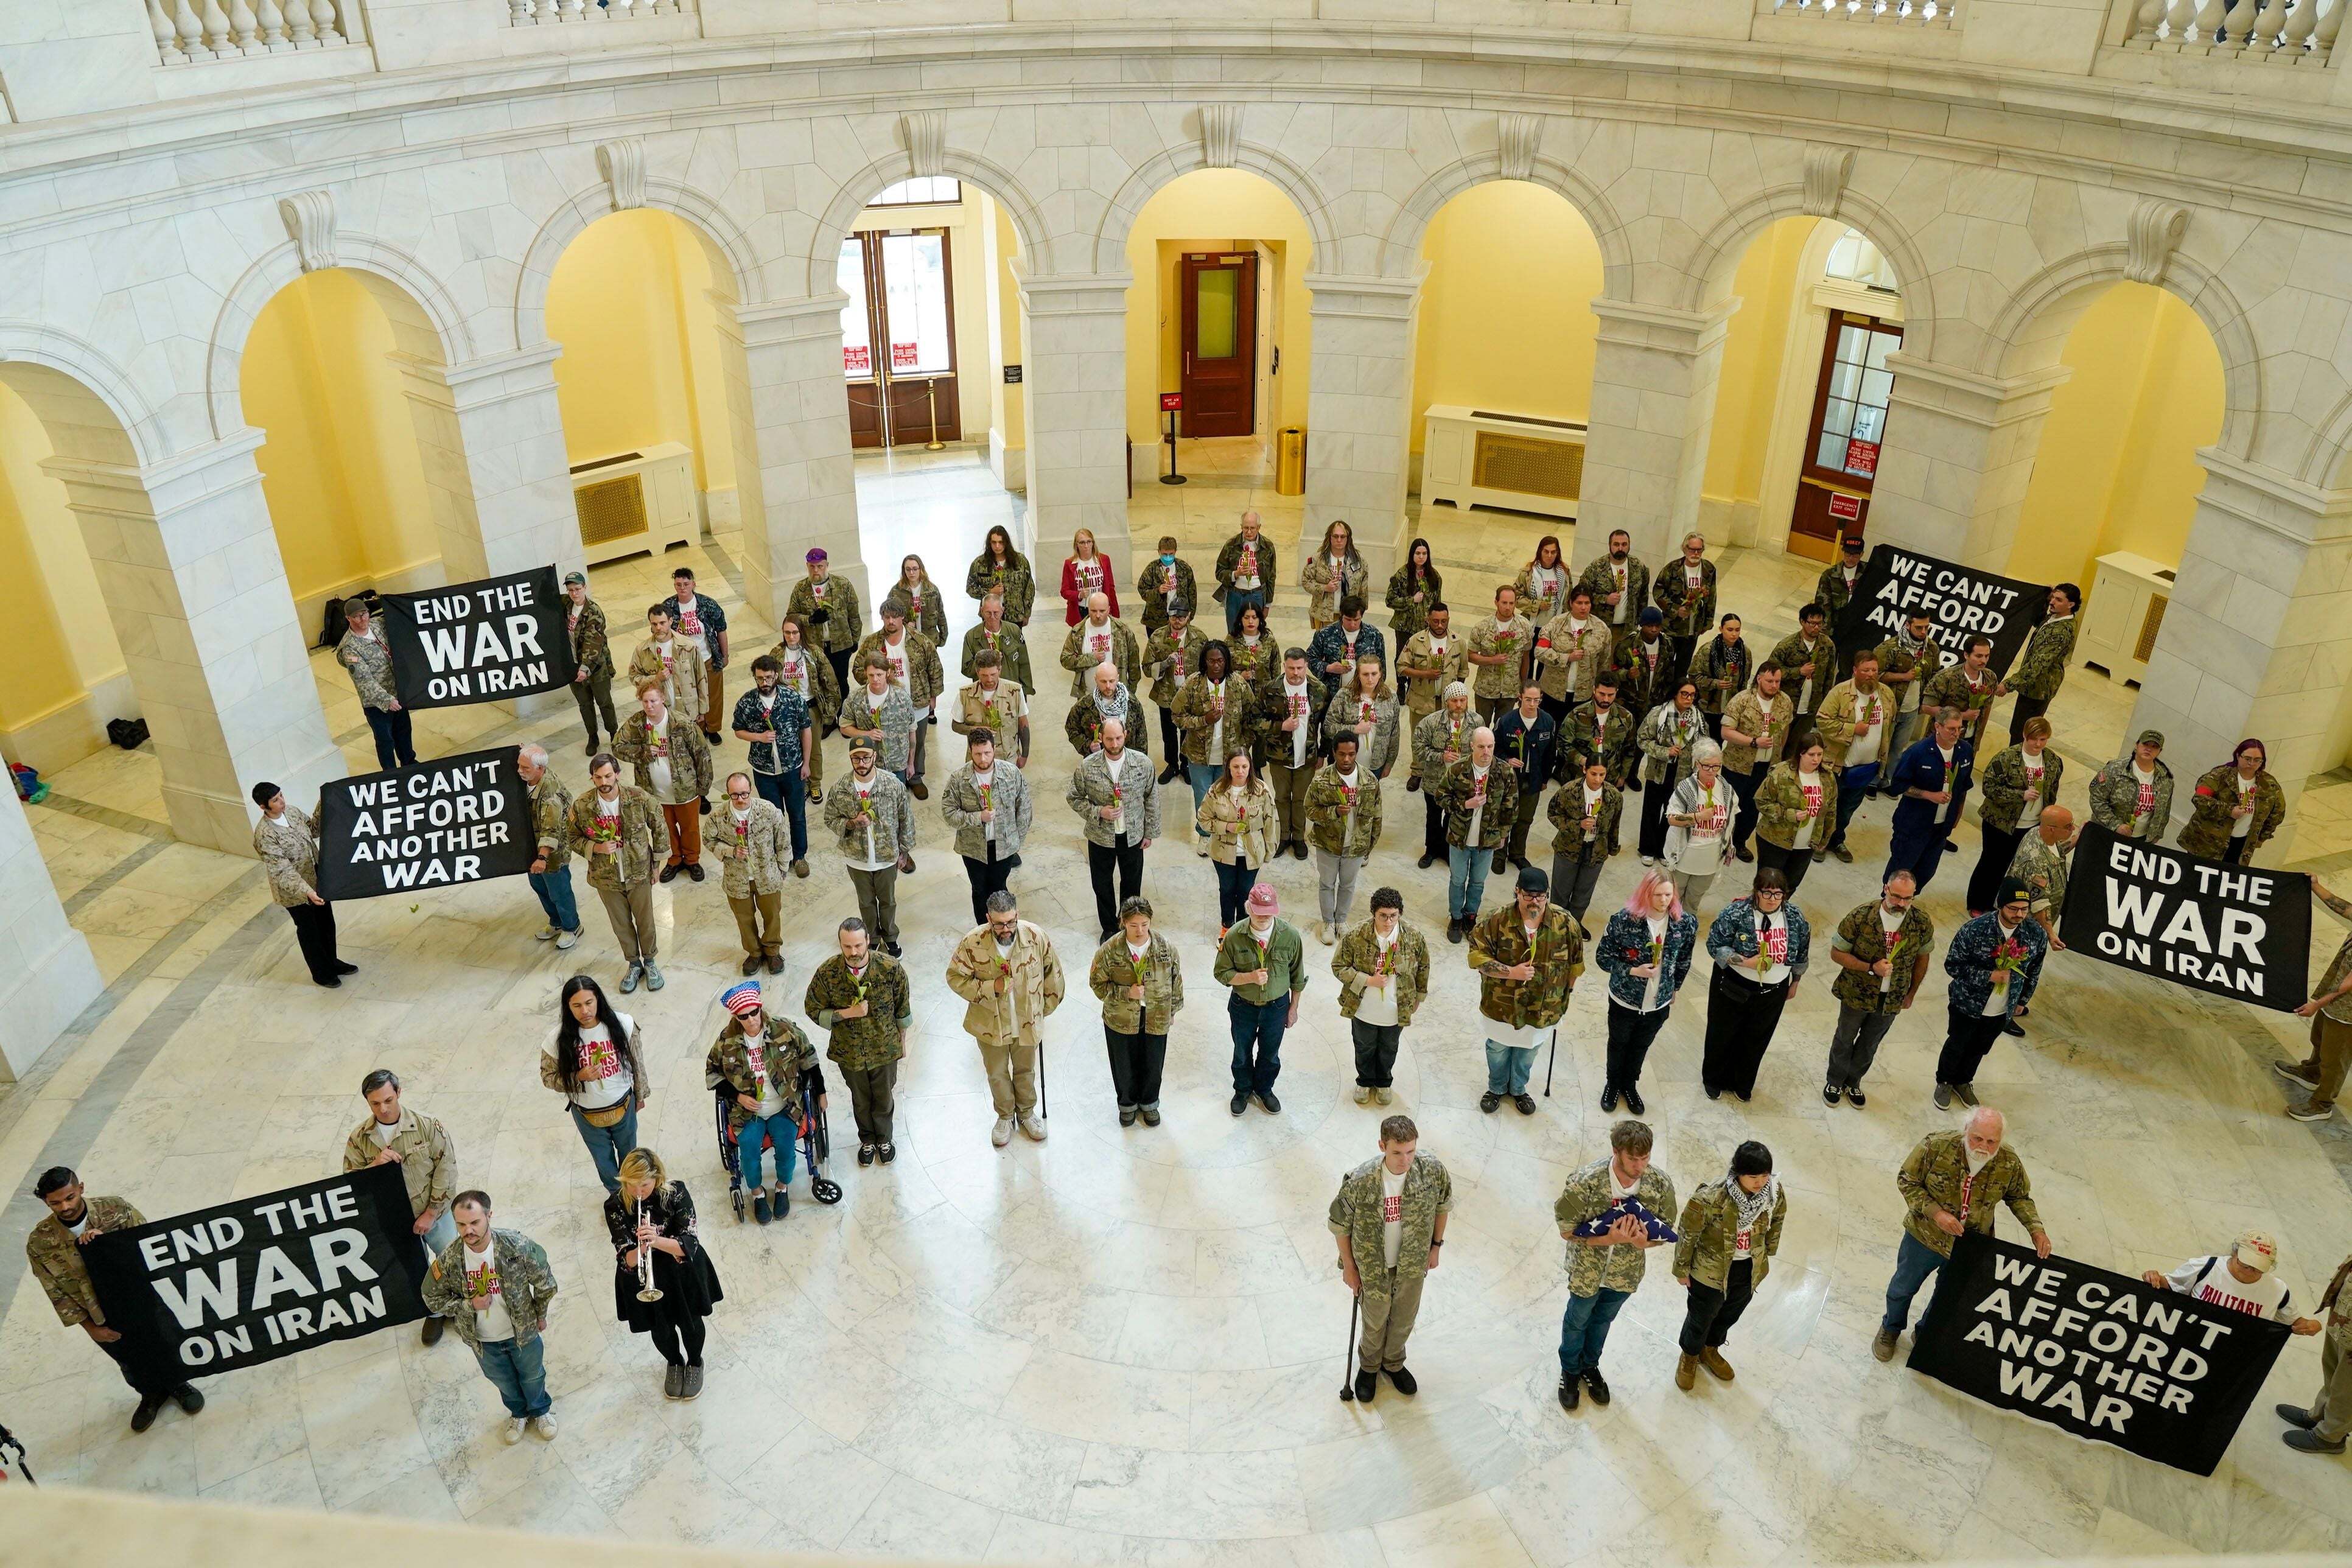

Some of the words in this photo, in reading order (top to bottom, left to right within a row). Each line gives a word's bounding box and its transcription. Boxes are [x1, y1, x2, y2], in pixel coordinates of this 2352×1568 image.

[1833, 500, 1857, 509] EMERGENCY
[414, 595, 471, 624] END
[477, 583, 534, 612] THE
[1876, 579, 2004, 634] AFFORD
[1891, 554, 1932, 584] WE
[1936, 570, 2019, 609] CAN'T
[418, 614, 544, 673] WAR
[428, 674, 471, 699] ON
[478, 661, 548, 693] IRAN
[349, 779, 399, 807] WE
[407, 760, 500, 799] CAN'T
[351, 790, 505, 838] AFFORD
[351, 821, 509, 863] ANOTHER
[382, 855, 480, 888] WAR
[2110, 841, 2182, 884] END
[2194, 865, 2273, 906] THE
[2105, 875, 2266, 966] WAR
[2097, 931, 2151, 965] ON
[2165, 950, 2263, 997] IRAN
[138, 1217, 243, 1271] END
[253, 1185, 359, 1236] THE
[151, 1227, 379, 1331] WAR
[1995, 1254, 2067, 1295] WE
[2077, 1283, 2232, 1350] CAN'T
[2199, 1284, 2263, 1317] MILITARY
[179, 1325, 253, 1365] ON
[264, 1286, 387, 1345] IRAN
[1975, 1287, 2208, 1381] AFFORD
[1963, 1321, 2194, 1414] ANOTHER
[2000, 1361, 2134, 1434] WAR
